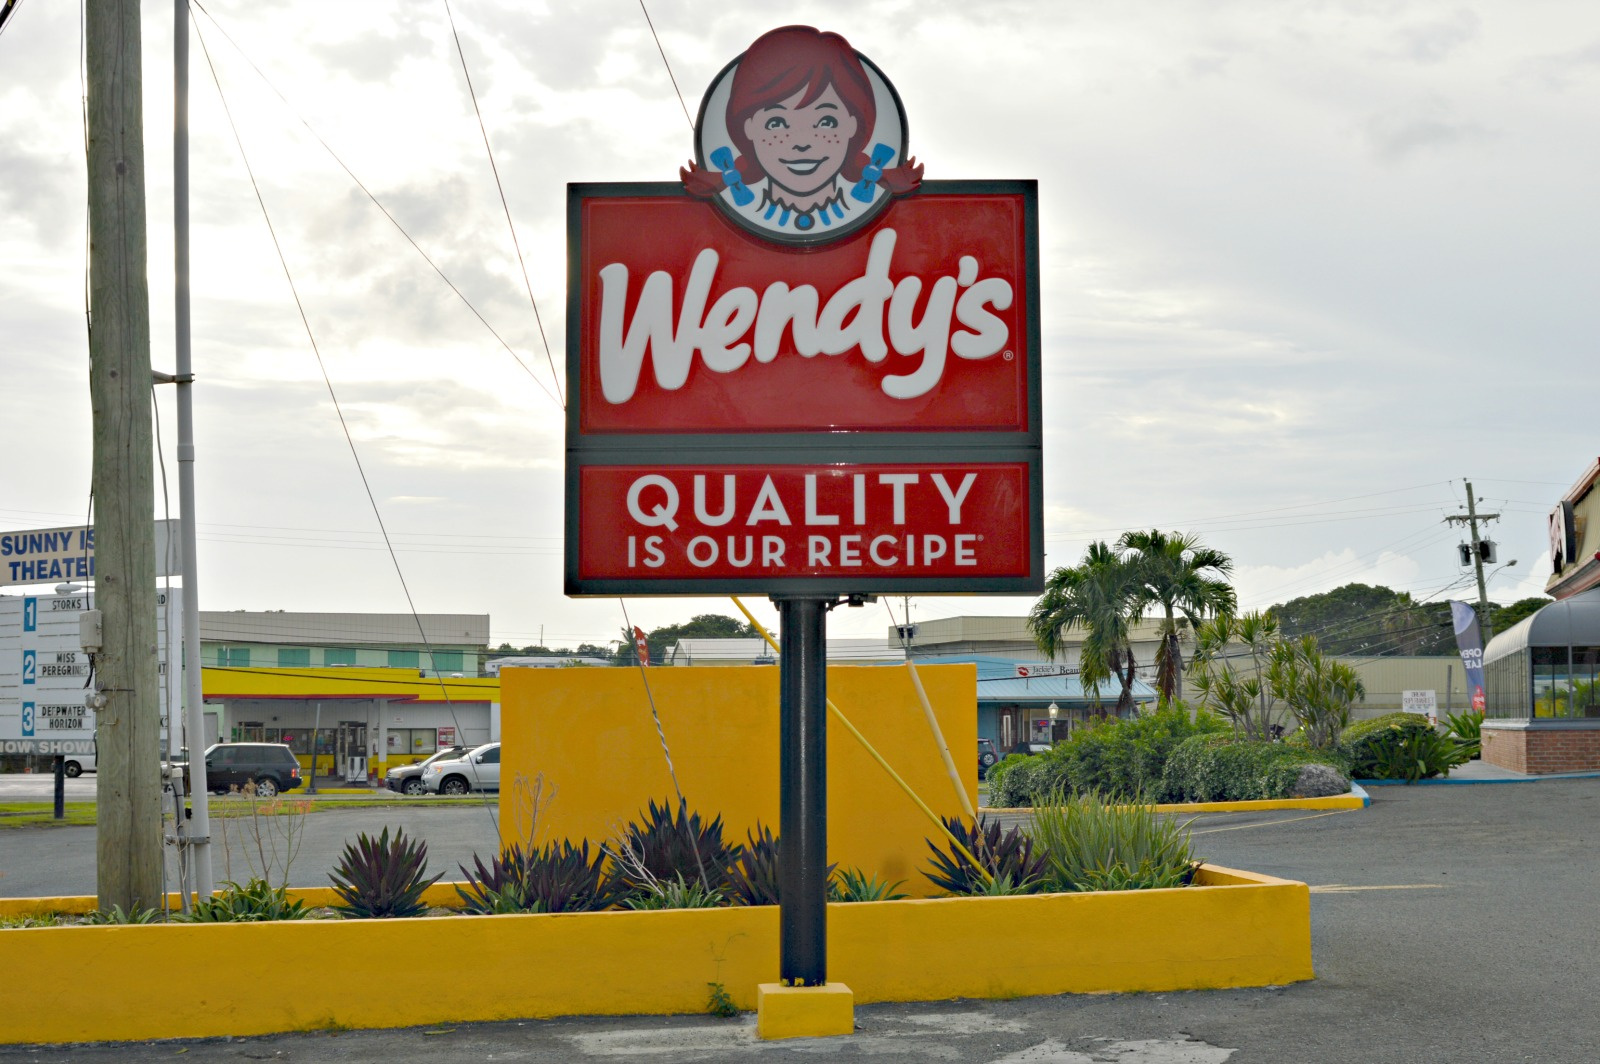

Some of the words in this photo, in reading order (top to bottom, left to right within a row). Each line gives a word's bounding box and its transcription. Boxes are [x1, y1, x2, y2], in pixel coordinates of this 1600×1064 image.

[599, 227, 1013, 404] Wendy's
[626, 473, 978, 532] QUALITY
[1, 531, 73, 556] SUNNY
[628, 535, 666, 568] IS
[686, 535, 786, 568] OUR
[26, 602, 34, 627] 1
[52, 599, 82, 610] STORKS
[24, 654, 35, 680] 2
[56, 653, 76, 663] MISS
[23, 706, 34, 732] 3
[49, 718, 83, 729] HORIZON
